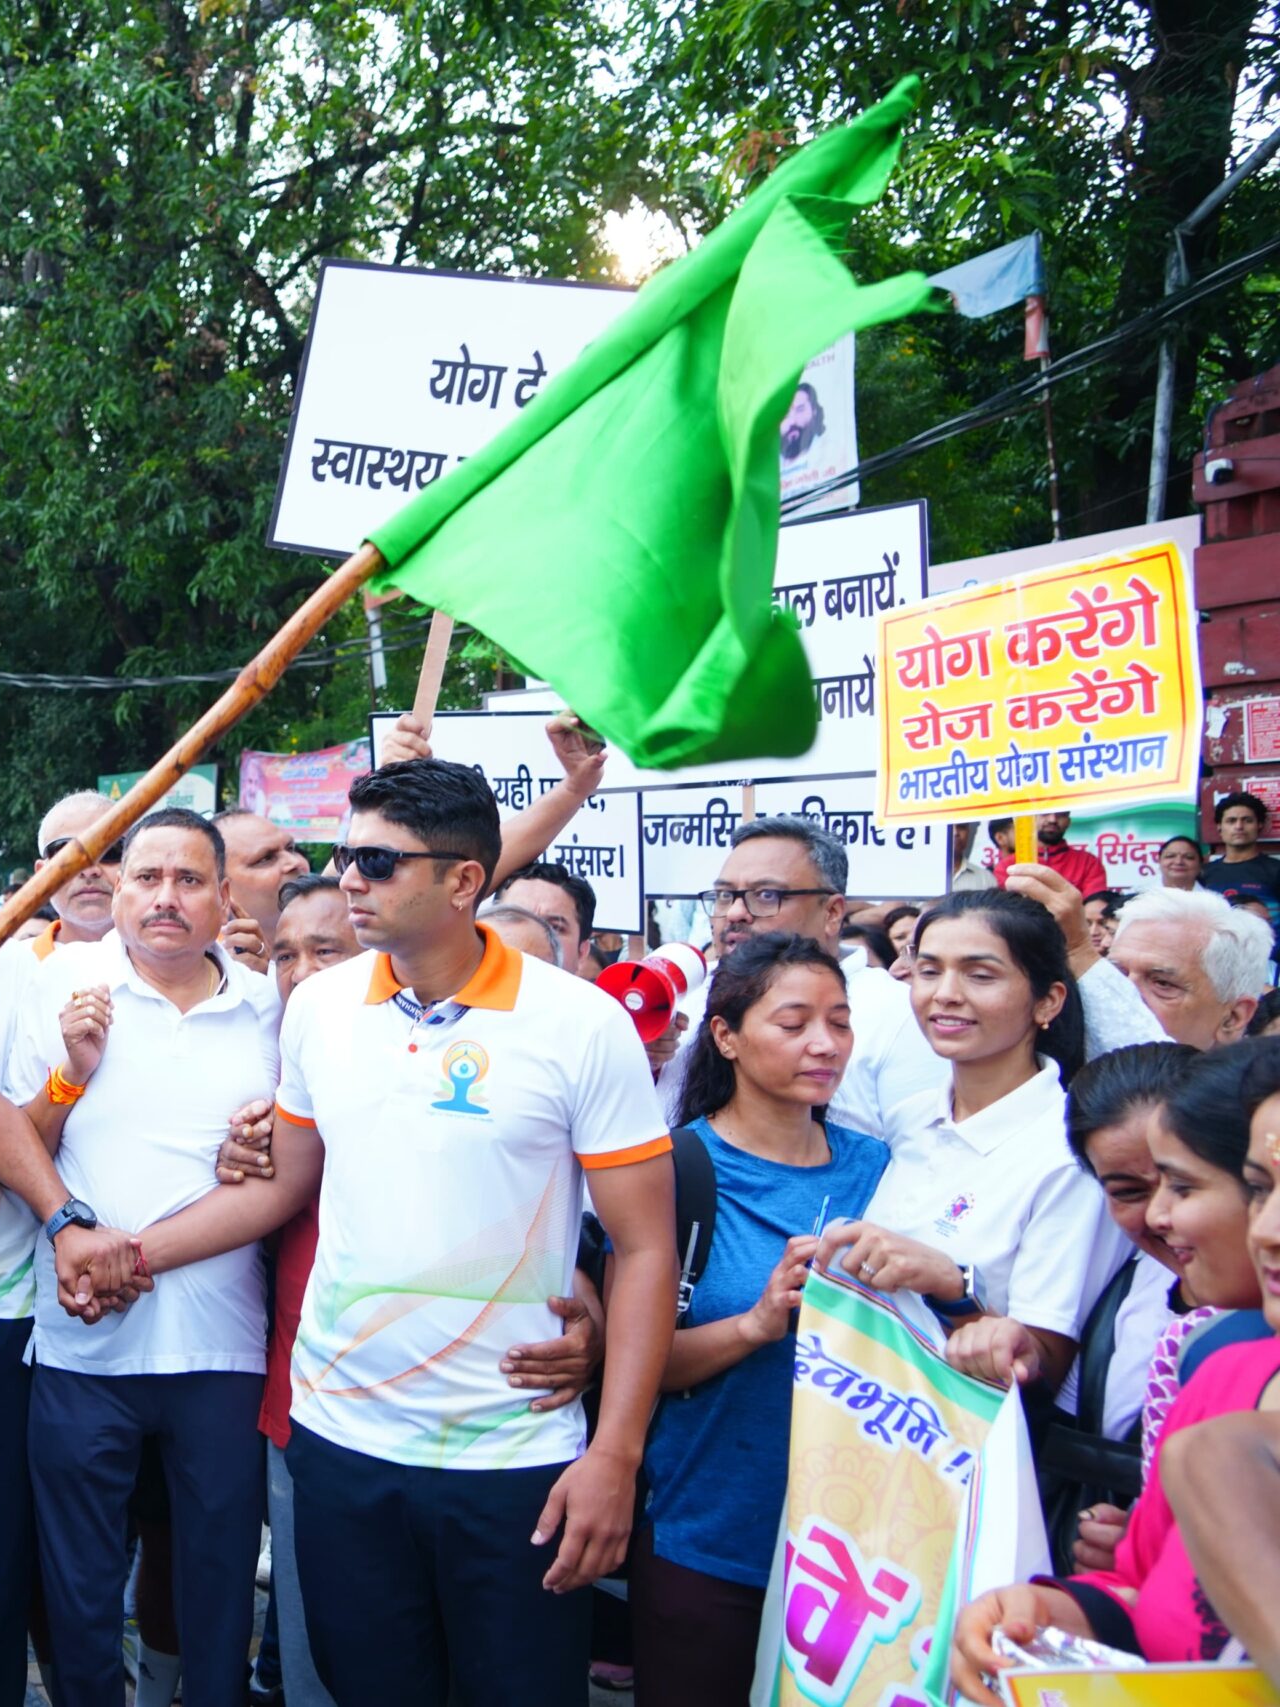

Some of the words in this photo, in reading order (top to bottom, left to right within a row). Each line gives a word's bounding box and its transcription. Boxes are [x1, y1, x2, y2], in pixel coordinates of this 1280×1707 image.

[429, 343, 508, 409] योग
[896, 624, 991, 689] योग
[1004, 577, 1160, 667] करेंगे
[902, 701, 993, 750] रोज
[1006, 662, 1160, 730] करेंगे
[493, 763, 533, 811] यही
[899, 749, 990, 800] भारतीय
[996, 742, 1050, 789] योग
[1058, 731, 1169, 783] संस्थान
